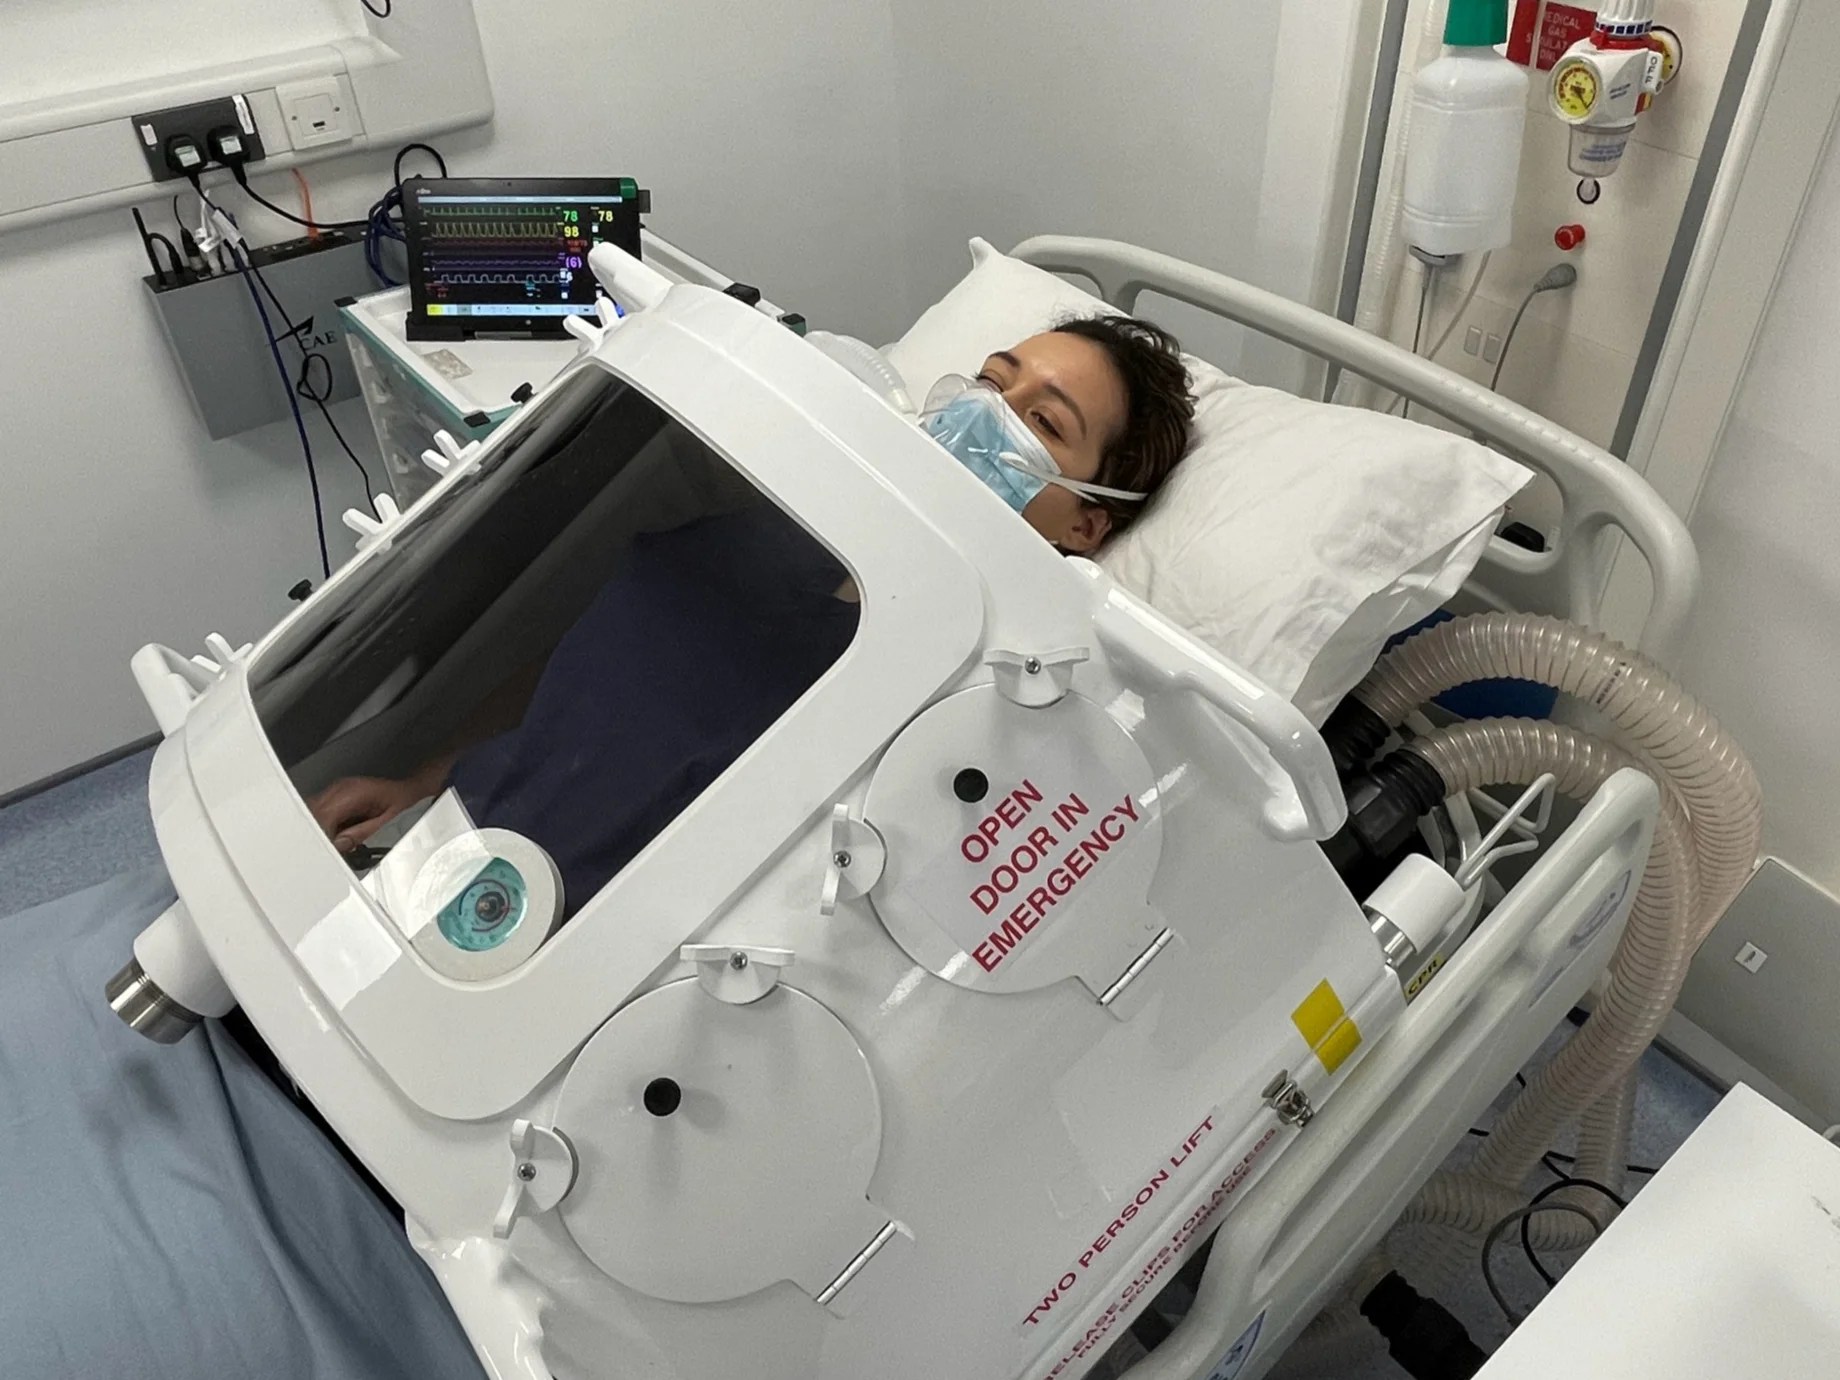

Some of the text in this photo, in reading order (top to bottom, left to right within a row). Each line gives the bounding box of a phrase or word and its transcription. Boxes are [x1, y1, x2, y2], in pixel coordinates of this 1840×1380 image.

[1544, 11, 1580, 30] EDICAL
[1548, 25, 1567, 39] GAS
[1645, 56, 1658, 84] OFF
[563, 210, 578, 222] 78
[564, 226, 579, 237] 98
[598, 210, 613, 222] 78
[566, 256, 582, 268] (6)
[961, 779, 1043, 863] OPEN
[970, 792, 1090, 915] DOOR IN
[972, 794, 1139, 972] EMERGENCY
[1408, 960, 1437, 994] CPR
[1023, 1115, 1213, 1325] TWO PERSON LIFT
[1121, 1246, 1170, 1299] CLIPS
[1172, 1204, 1208, 1243] FOR
[1211, 1128, 1276, 1202] ACCESS
[1078, 1165, 1252, 1358] FULLY SECURE BEFORE USE
